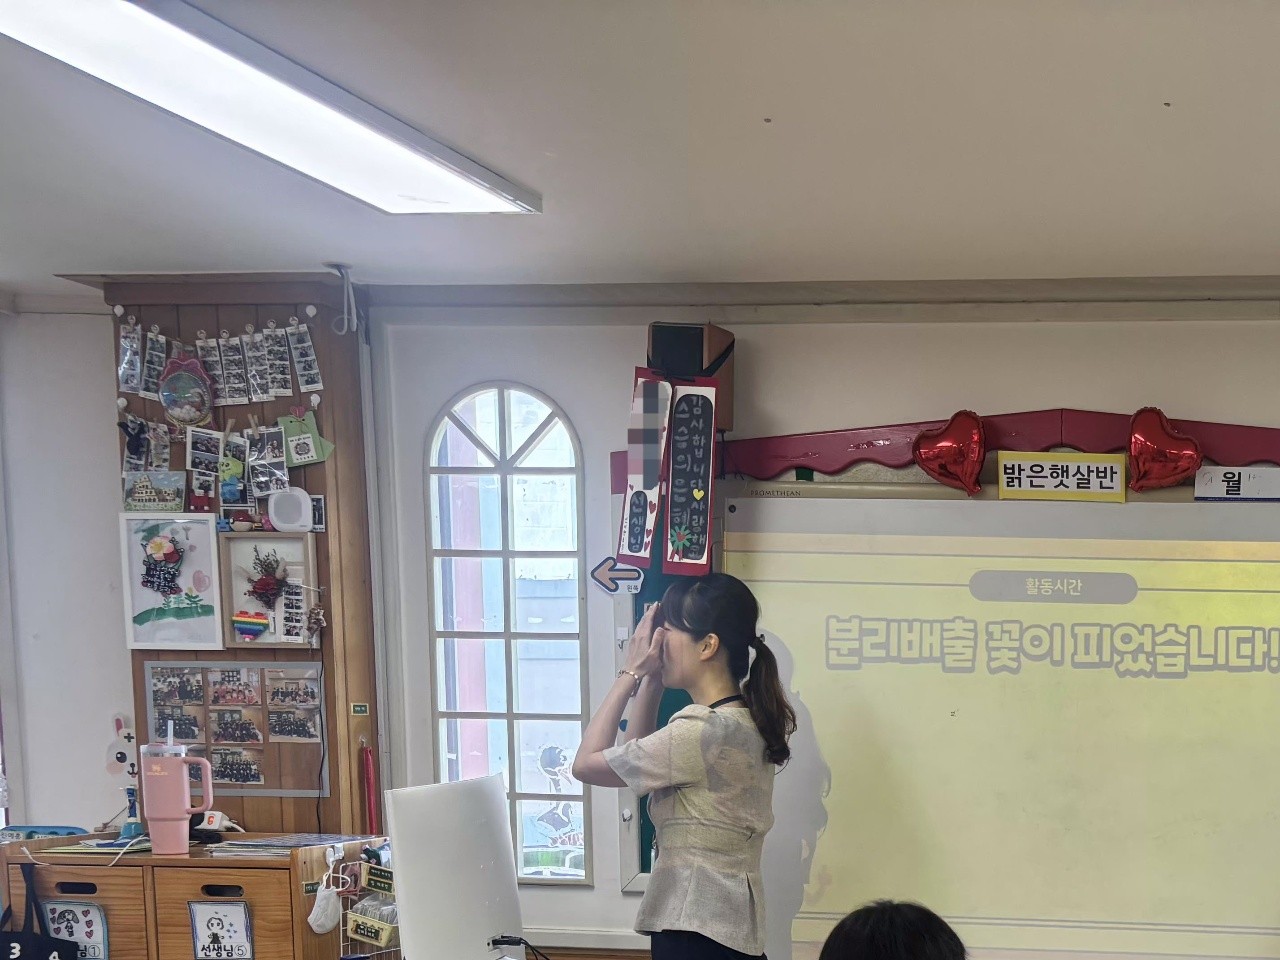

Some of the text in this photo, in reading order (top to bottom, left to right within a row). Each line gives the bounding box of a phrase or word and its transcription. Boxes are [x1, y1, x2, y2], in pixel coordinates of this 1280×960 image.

[1003, 463, 1118, 491] 밝은햇살반
[1221, 471, 1242, 496] 월
[750, 489, 802, 497] PROMETHEAN
[1025, 578, 1083, 596] 활동시간
[826, 616, 977, 672] 분리배출
[985, 620, 1064, 674] 꽃이
[9, 942, 21, 959] 3
